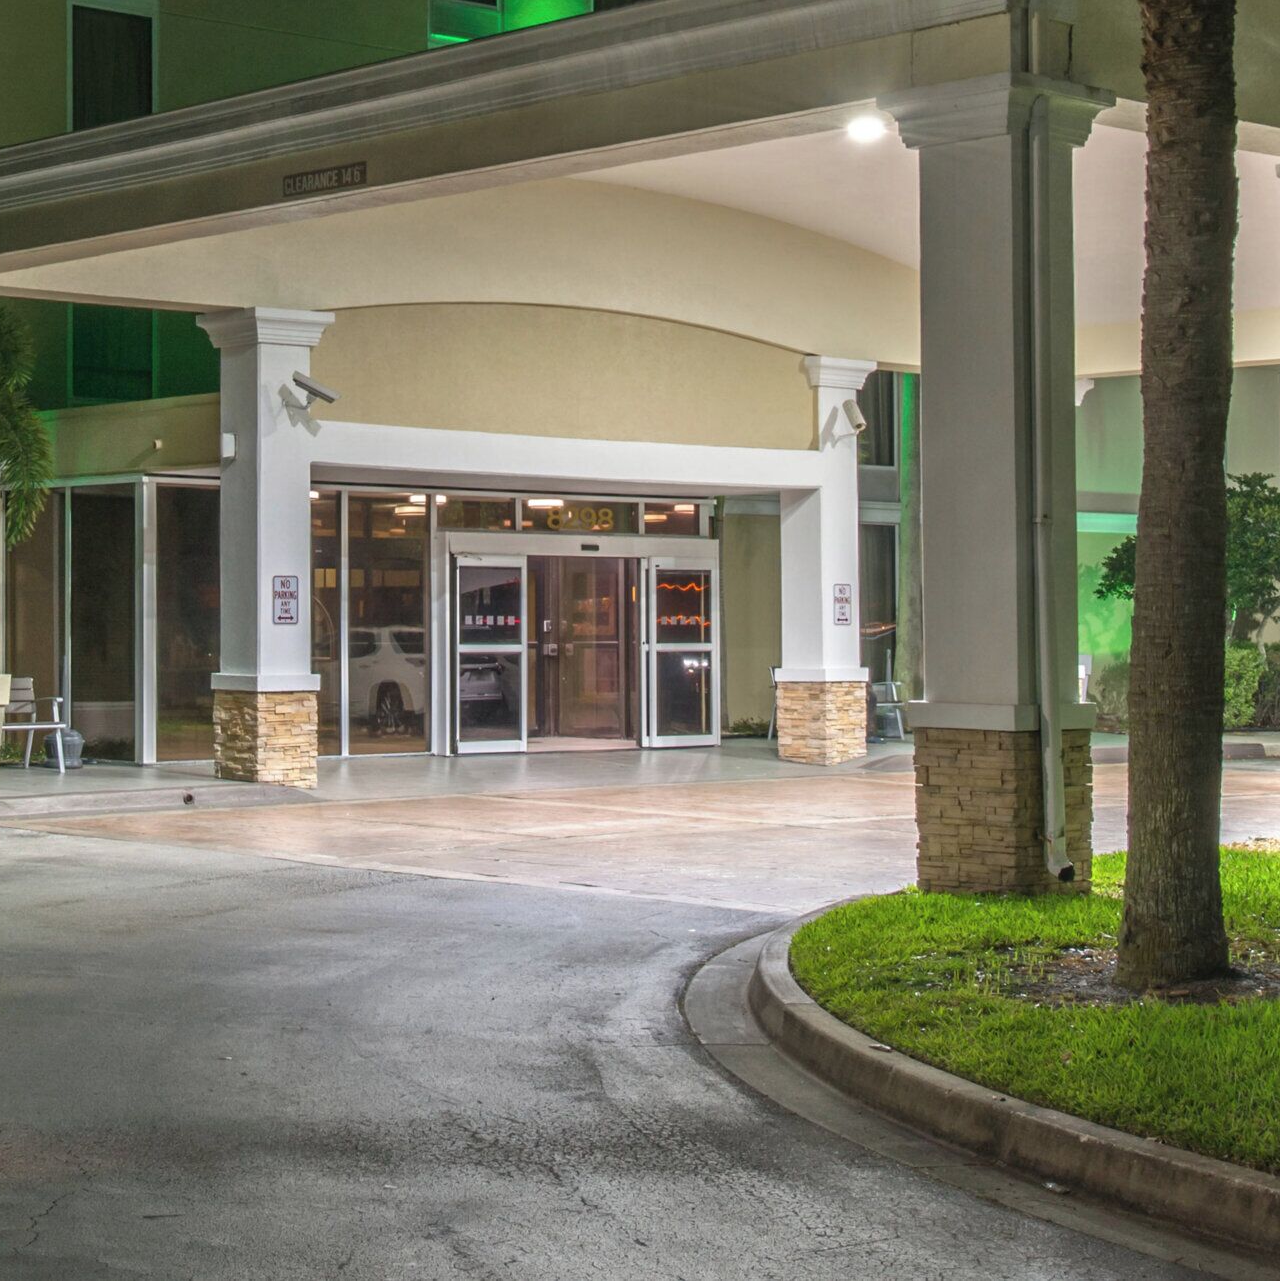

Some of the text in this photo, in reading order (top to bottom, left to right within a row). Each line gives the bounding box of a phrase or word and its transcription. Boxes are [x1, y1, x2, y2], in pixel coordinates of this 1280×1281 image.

[284, 170, 338, 194] CLEARANCE
[546, 506, 614, 531] 8298
[280, 580, 291, 589] NO
[274, 590, 297, 600] PARKING
